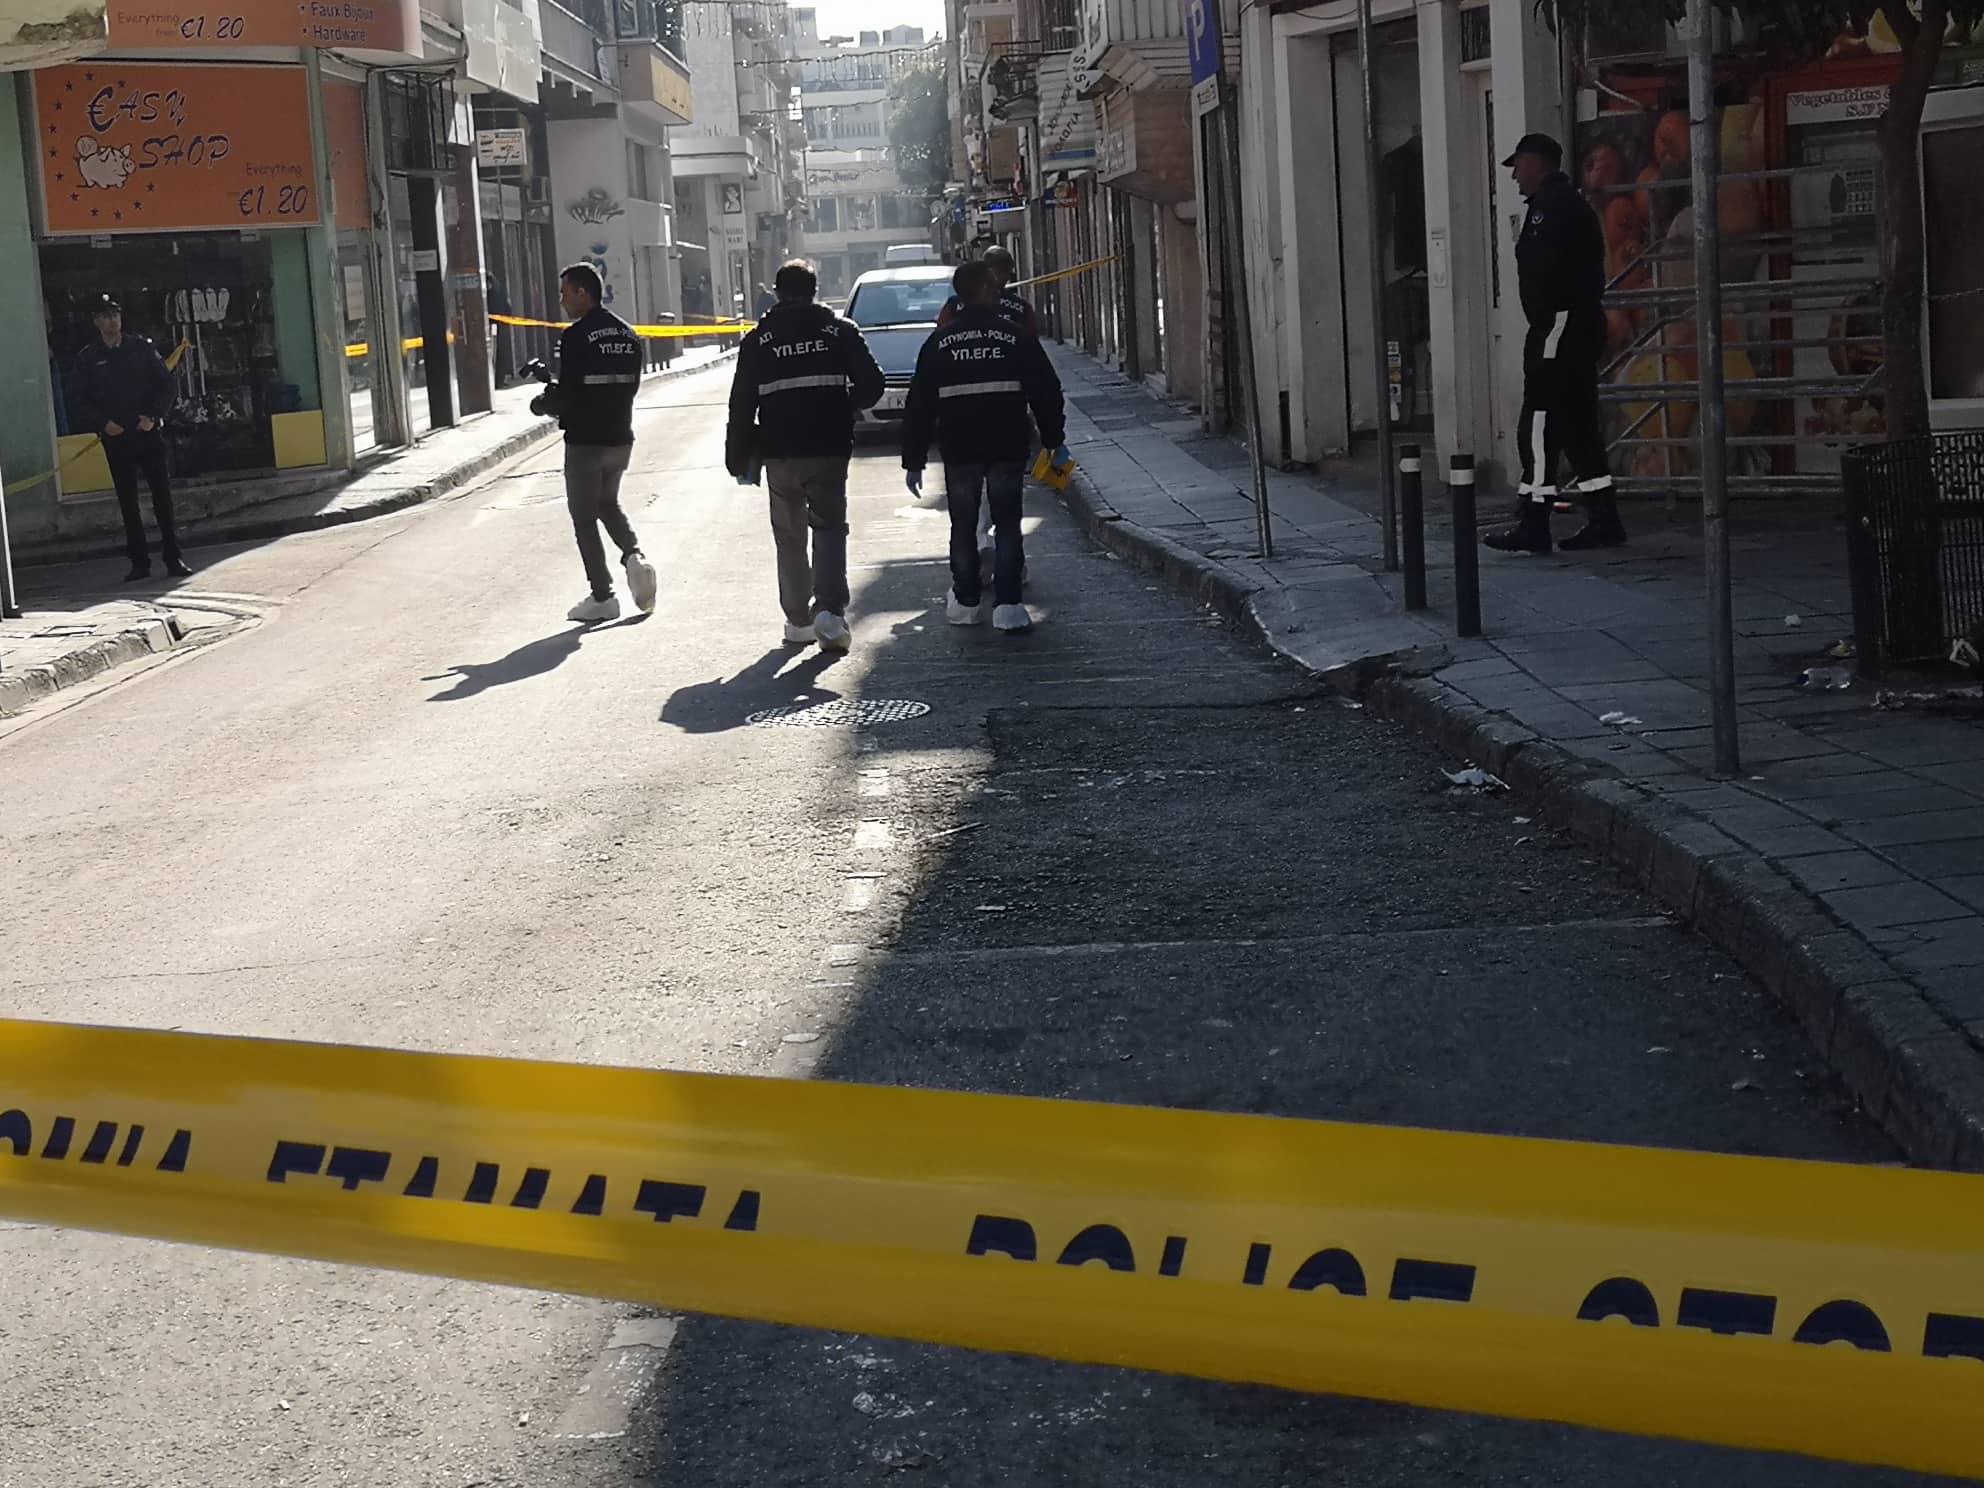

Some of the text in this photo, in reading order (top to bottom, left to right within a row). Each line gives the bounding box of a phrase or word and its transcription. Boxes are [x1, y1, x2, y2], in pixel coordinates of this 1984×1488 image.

[117, 11, 180, 25] Everything
[180, 15, 245, 40] €1.20
[313, 24, 368, 42] Hardware
[1191, 0, 1204, 62] P
[1791, 88, 1880, 107] Vegetables
[139, 133, 230, 169] SHOP
[246, 163, 303, 177] Everything
[238, 184, 309, 215] €1.20
[988, 329, 1016, 345] POLICE
